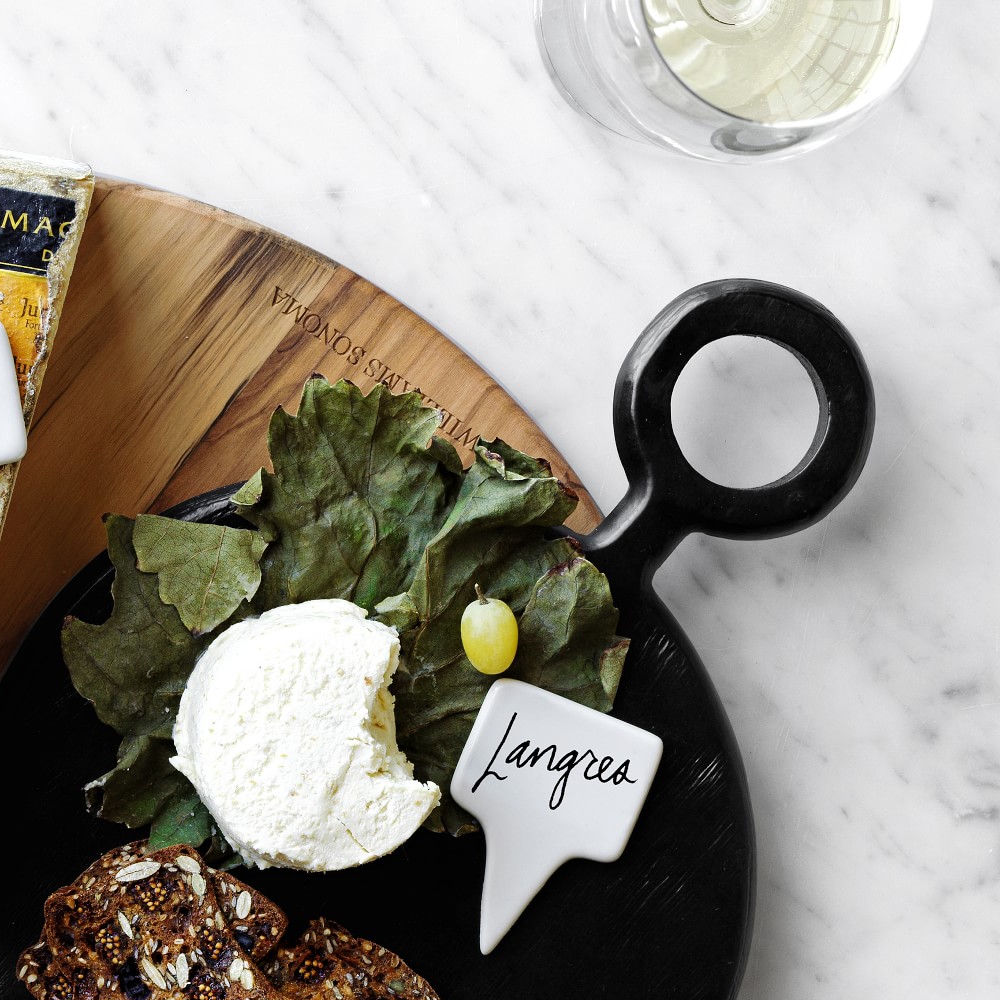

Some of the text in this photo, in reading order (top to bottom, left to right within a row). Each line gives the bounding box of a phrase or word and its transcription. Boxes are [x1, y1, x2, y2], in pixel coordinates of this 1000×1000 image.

[270, 285, 482, 452] WILMS SONOMA
[471, 711, 639, 811] Langres
